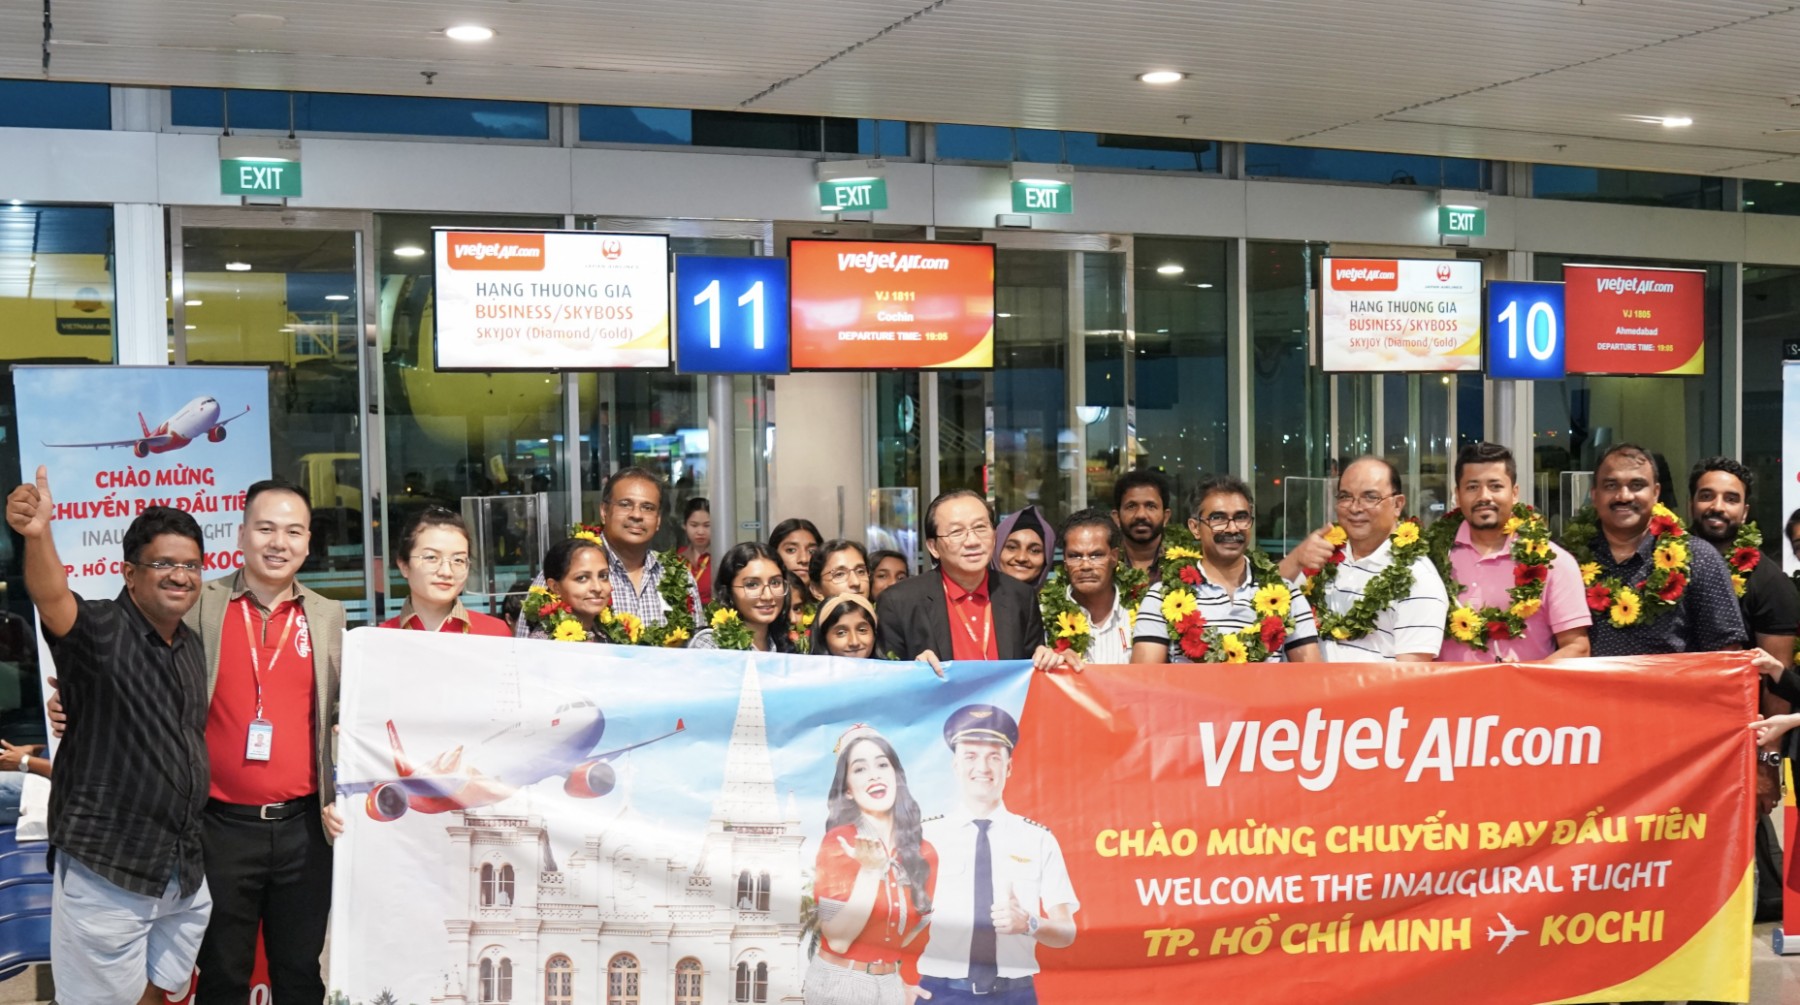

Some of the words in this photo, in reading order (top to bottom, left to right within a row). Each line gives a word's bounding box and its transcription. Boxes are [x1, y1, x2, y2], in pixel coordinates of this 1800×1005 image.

[240, 166, 283, 190] EXIT
[835, 185, 872, 206] EXIT
[1025, 187, 1059, 208] EXIT
[1449, 212, 1475, 231] EXIT
[476, 283, 524, 301] HẠNG
[604, 285, 632, 298] GIA
[875, 291, 889, 301] VJ
[892, 291, 915, 301] 1811
[476, 304, 633, 323] BUSINESS/SKYBOSS
[693, 280, 764, 349] 11
[877, 311, 914, 322] Cochin
[1438, 301, 1457, 313] GIA
[1622, 309, 1633, 318] VJ
[477, 328, 521, 341] SKYJOY
[526, 327, 633, 341] (Diamond/Gold)
[1350, 318, 1457, 335] BUSINESS/SKYBOSS
[1498, 301, 1557, 360] 10
[1615, 326, 1658, 336] Ahmedabad
[838, 332, 895, 341] DEPARTURE
[897, 332, 922, 341] TIME:
[925, 332, 948, 341] 19:05
[1350, 338, 1380, 349] SKYJOY
[1384, 337, 1457, 349] (Diamond/Gold)
[1597, 342, 1637, 351] DEPARTURE
[1638, 343, 1655, 351] TIME:
[95, 465, 151, 489] CHÀO
[155, 462, 215, 487] MỪNG
[176, 489, 218, 513] ĐẦU
[221, 490, 247, 512] TIÊ
[64, 565, 79, 578] P.
[82, 557, 106, 576] HỒ
[203, 550, 245, 571] KOC
[1095, 821, 1198, 857] CHÀO
[1206, 818, 1317, 857] MỪNG
[1325, 810, 1469, 853] CHUYẾN
[1478, 820, 1549, 850] BAY
[1550, 805, 1629, 845] ĐẦU
[1634, 806, 1707, 843] TIÊN
[1135, 875, 1304, 906] WELCOME
[1310, 873, 1373, 902] THE
[1381, 865, 1563, 899] INAUGURAL
[1570, 860, 1672, 892] FLIGHT
[1143, 927, 1200, 957] TP.
[1209, 913, 1281, 955] HỒ
[1280, 913, 1355, 954] CHÍ
[1359, 917, 1471, 953] MINH
[1539, 909, 1665, 947] KOCHI
